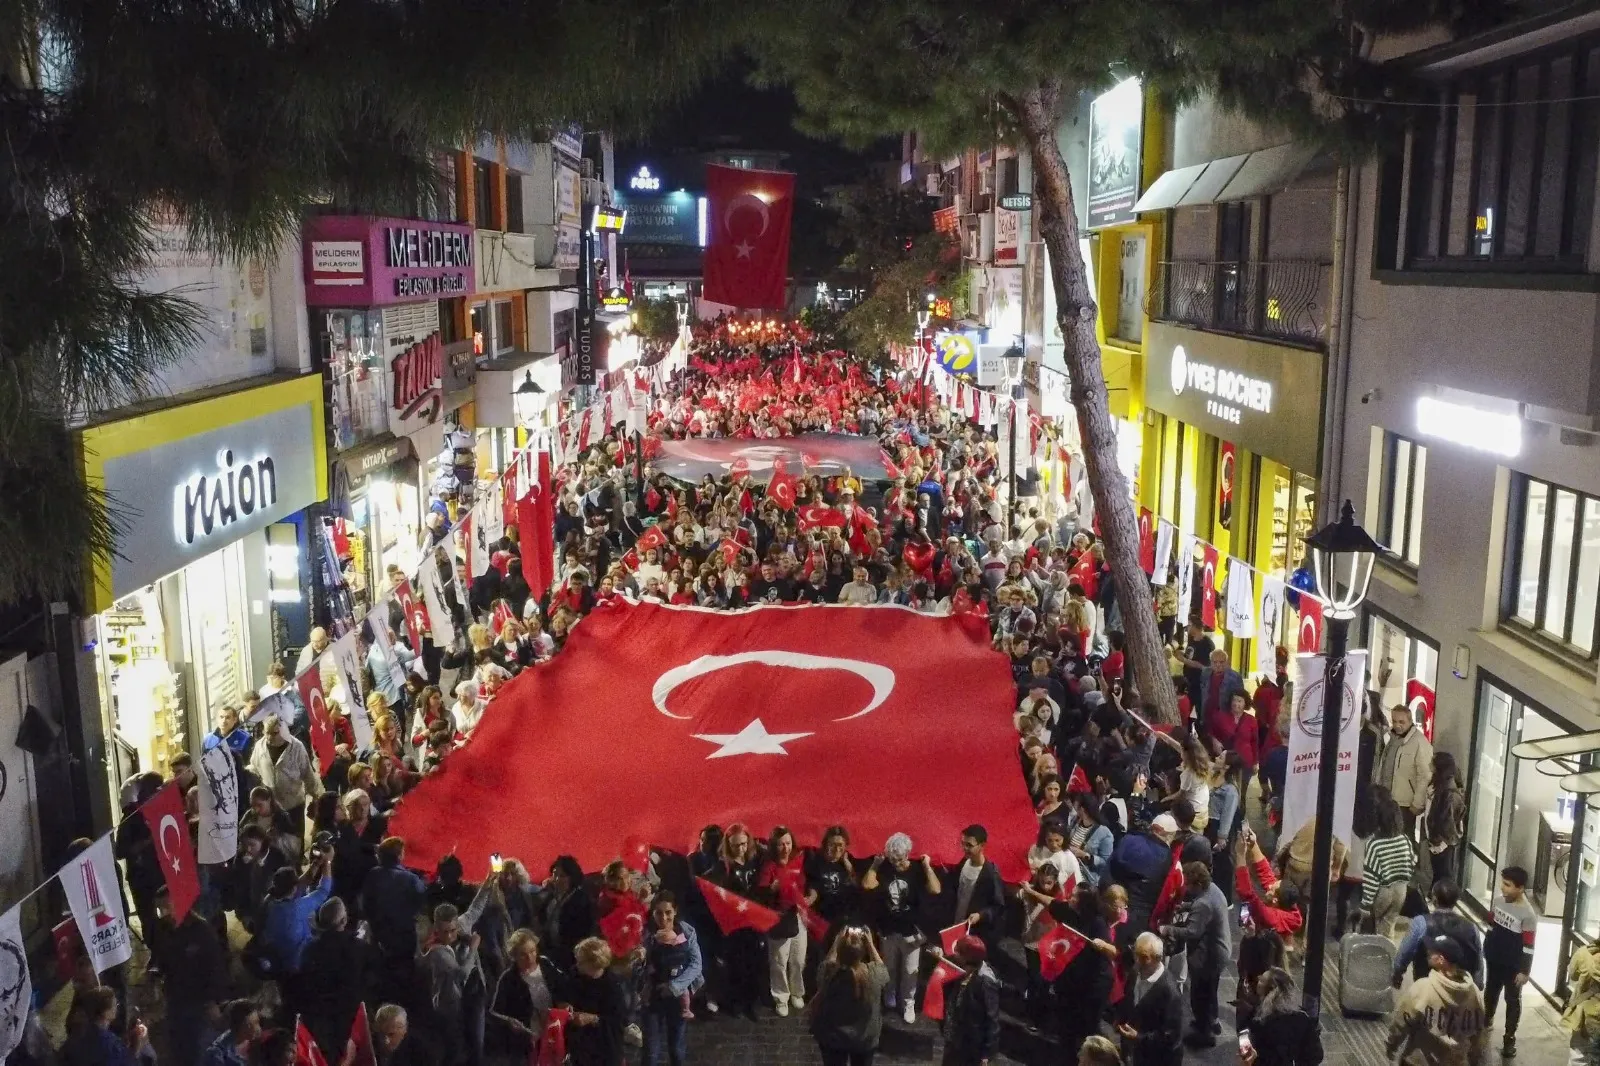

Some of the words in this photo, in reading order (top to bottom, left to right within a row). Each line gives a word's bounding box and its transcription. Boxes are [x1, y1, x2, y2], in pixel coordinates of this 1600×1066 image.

[616, 204, 678, 216] ARŞIYAKA'NIN
[581, 328, 591, 380] TUDORS
[1187, 361, 1216, 394] YVES
[1217, 369, 1272, 413] ROCHER
[1207, 400, 1240, 424] FRANCE
[180, 449, 276, 544] mion
